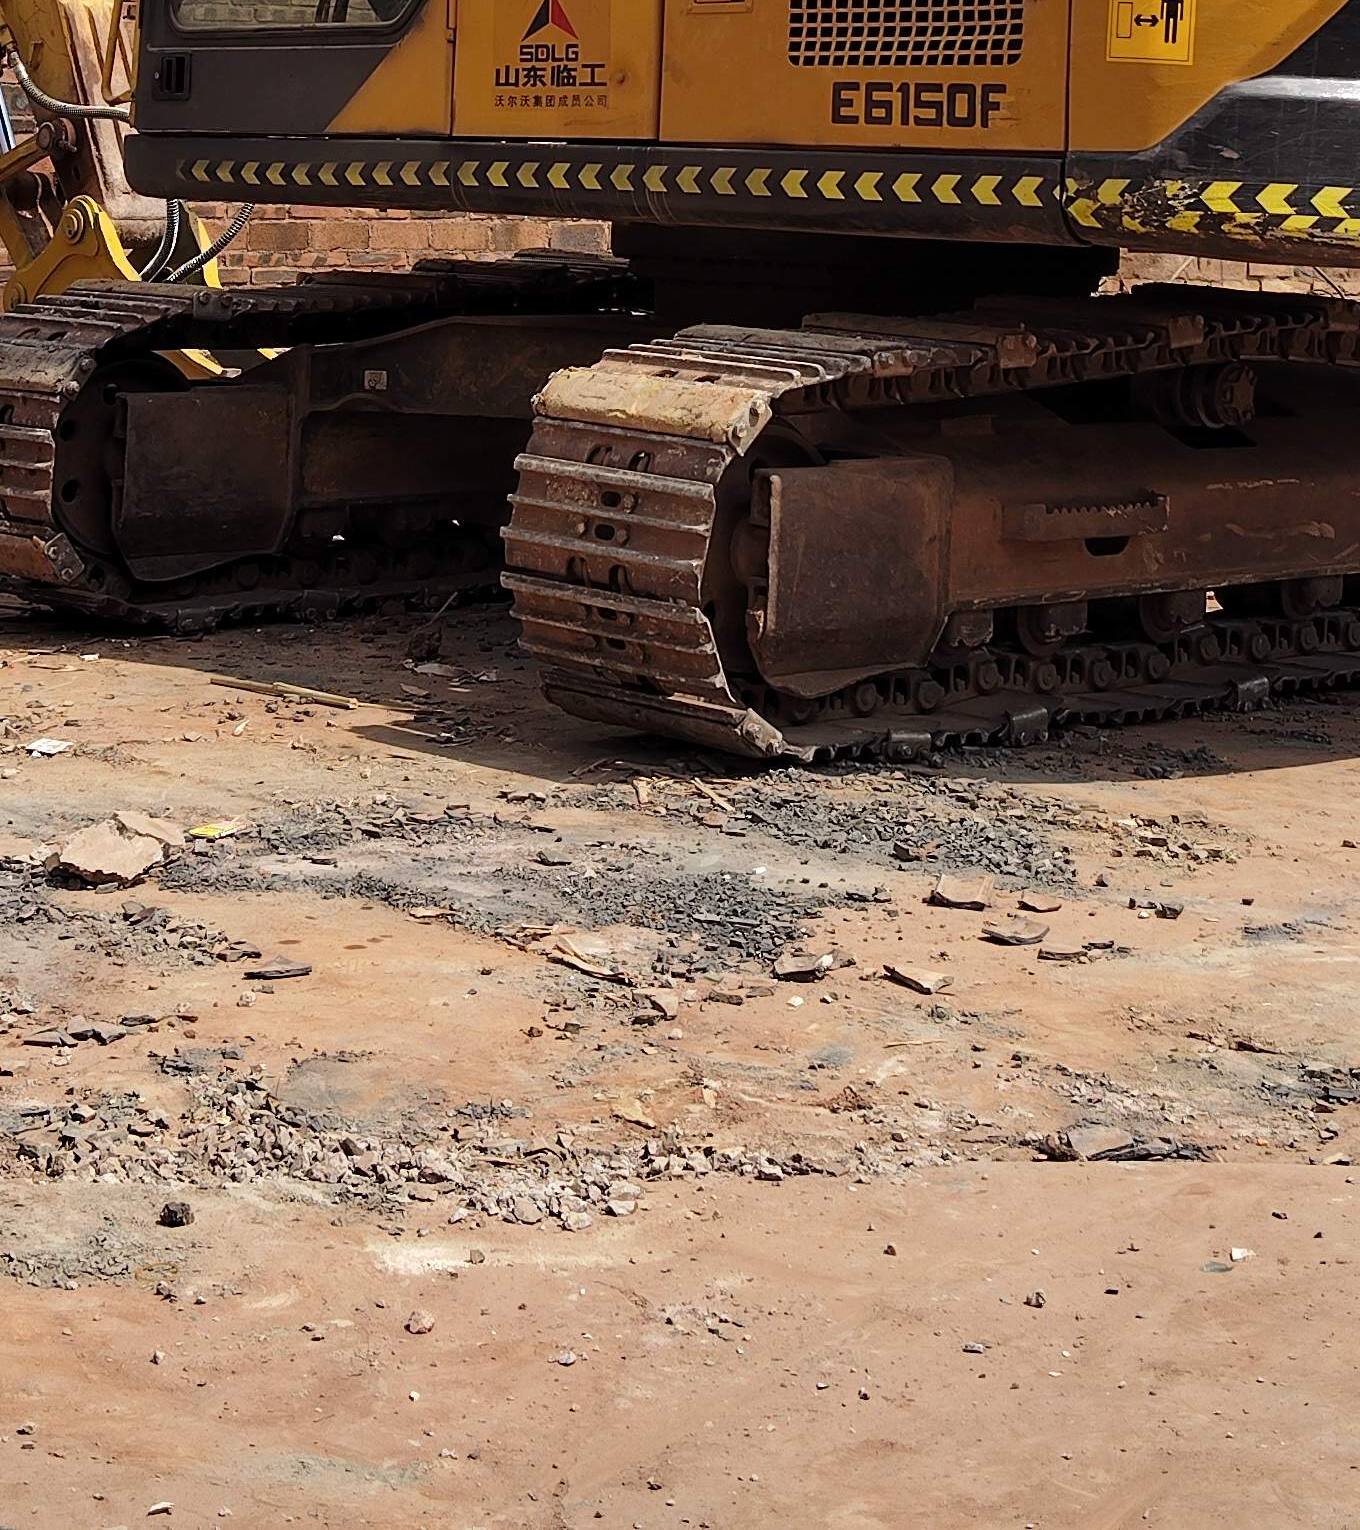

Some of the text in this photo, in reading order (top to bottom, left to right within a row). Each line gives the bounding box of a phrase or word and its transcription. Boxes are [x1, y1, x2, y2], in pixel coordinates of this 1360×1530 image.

[519, 43, 580, 63] SDLG
[494, 63, 608, 88] 山东临工
[493, 94, 609, 109] 沃尔沃集团成员公司
[830, 81, 1008, 129] E6150F
